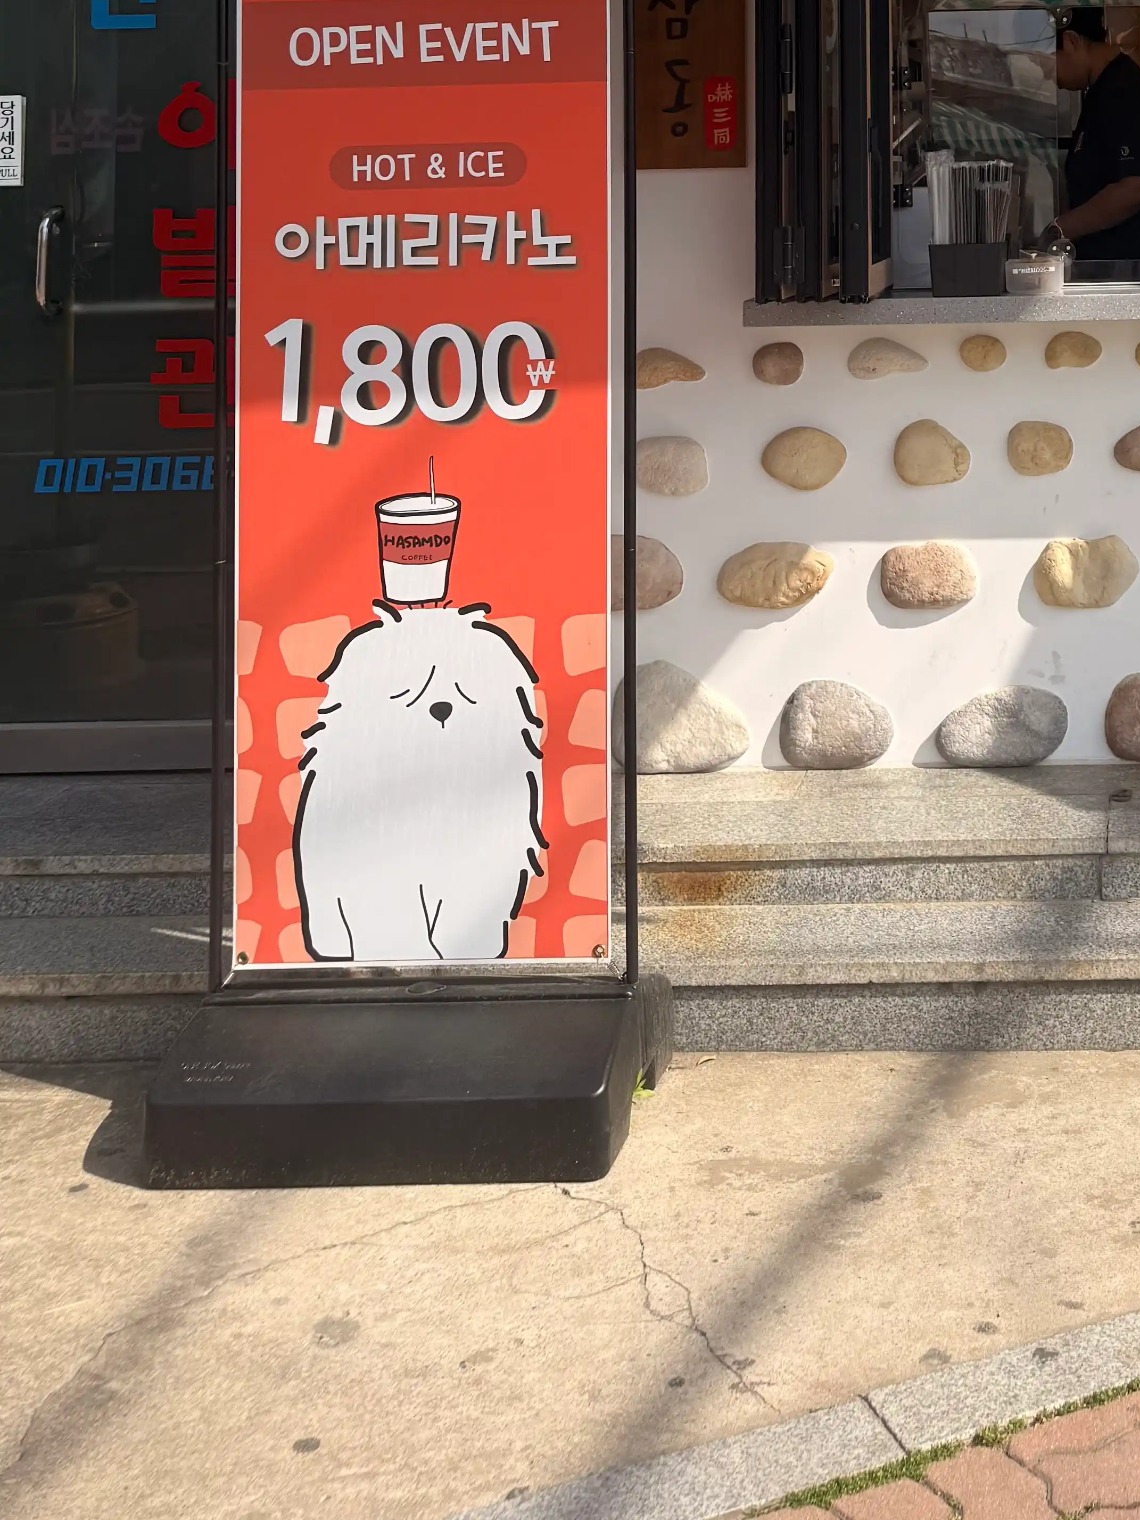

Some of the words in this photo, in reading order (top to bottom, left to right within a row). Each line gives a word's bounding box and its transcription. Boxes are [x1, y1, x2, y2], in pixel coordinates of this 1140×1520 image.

[288, 22, 403, 68] OPEN
[419, 20, 559, 65] EVENT
[0, 100, 15, 160] 당기세요
[0, 168, 18, 179] ULL
[351, 153, 416, 182] HOT
[426, 153, 446, 178] &
[457, 151, 505, 178] ICE
[274, 209, 578, 270] 아메리카노
[384, 534, 451, 549] HASAMDO
